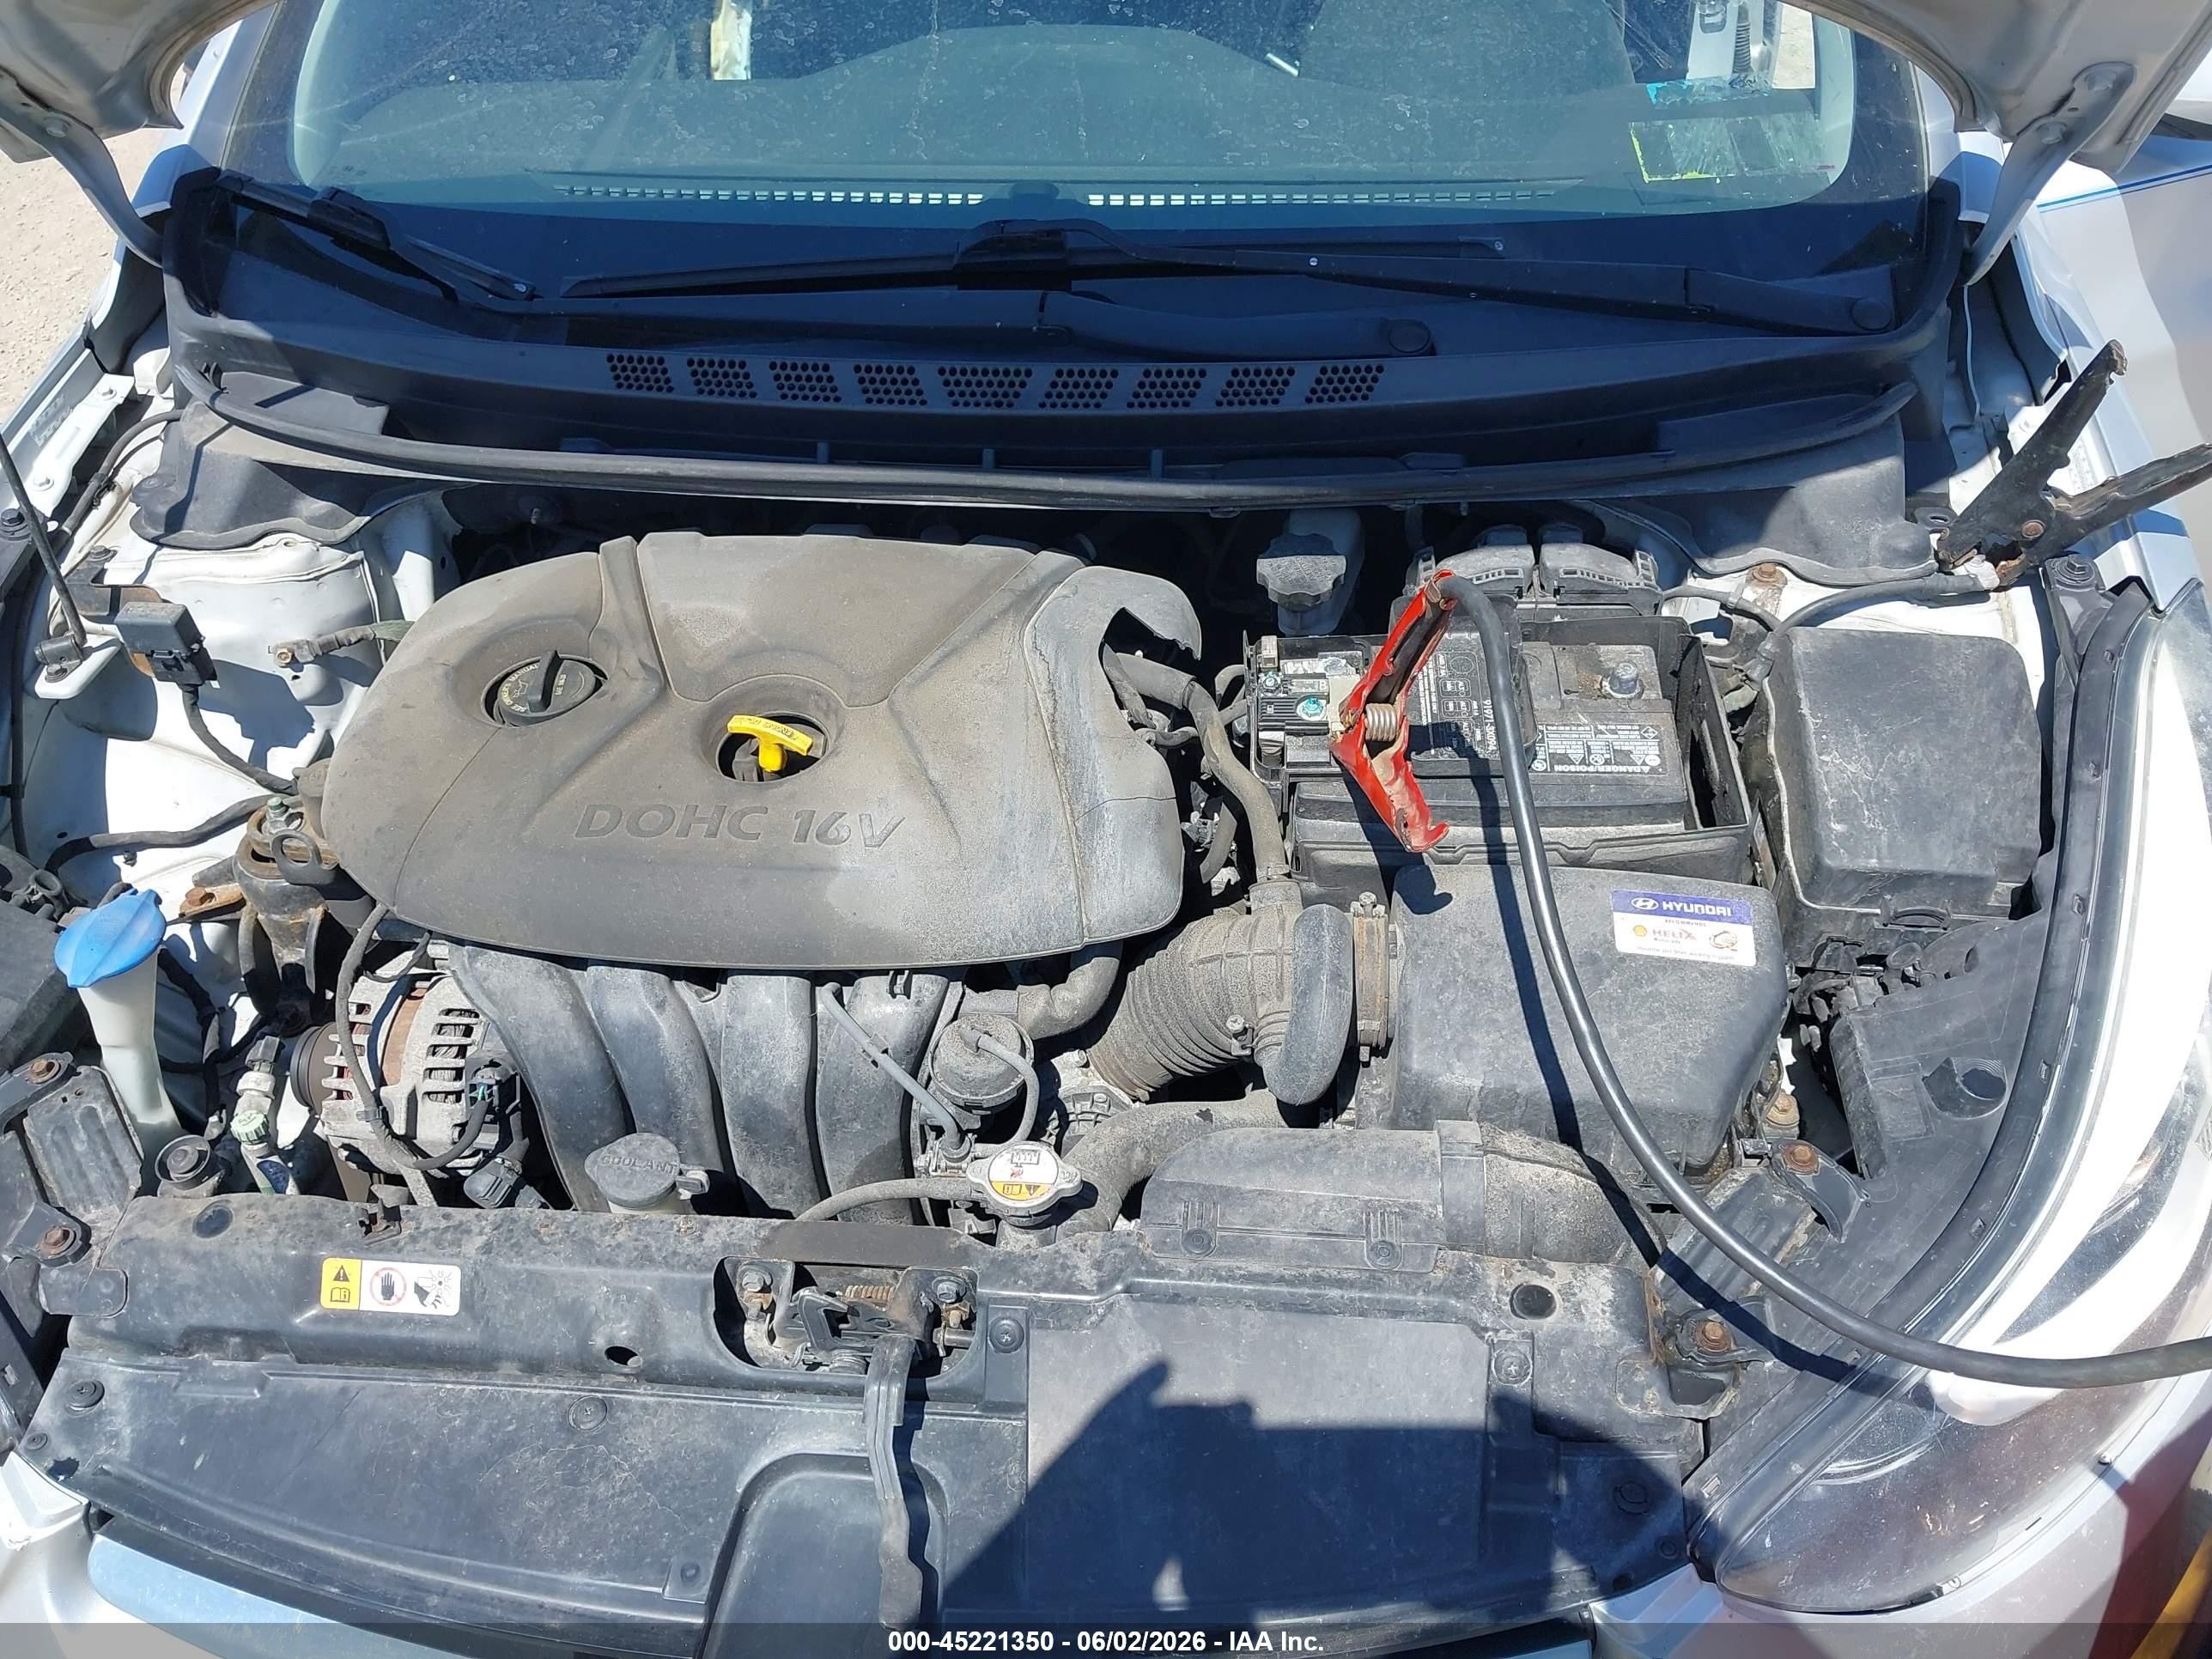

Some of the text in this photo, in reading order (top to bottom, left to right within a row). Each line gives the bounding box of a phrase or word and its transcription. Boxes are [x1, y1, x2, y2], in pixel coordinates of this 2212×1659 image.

[1482, 699, 1498, 750] 91971-3X094
[574, 803, 906, 848] DOHC 16V
[1662, 901, 1732, 916] HYUNDAI
[1652, 928, 1697, 940] HELIX
[603, 1155, 678, 1175] COOLANT
